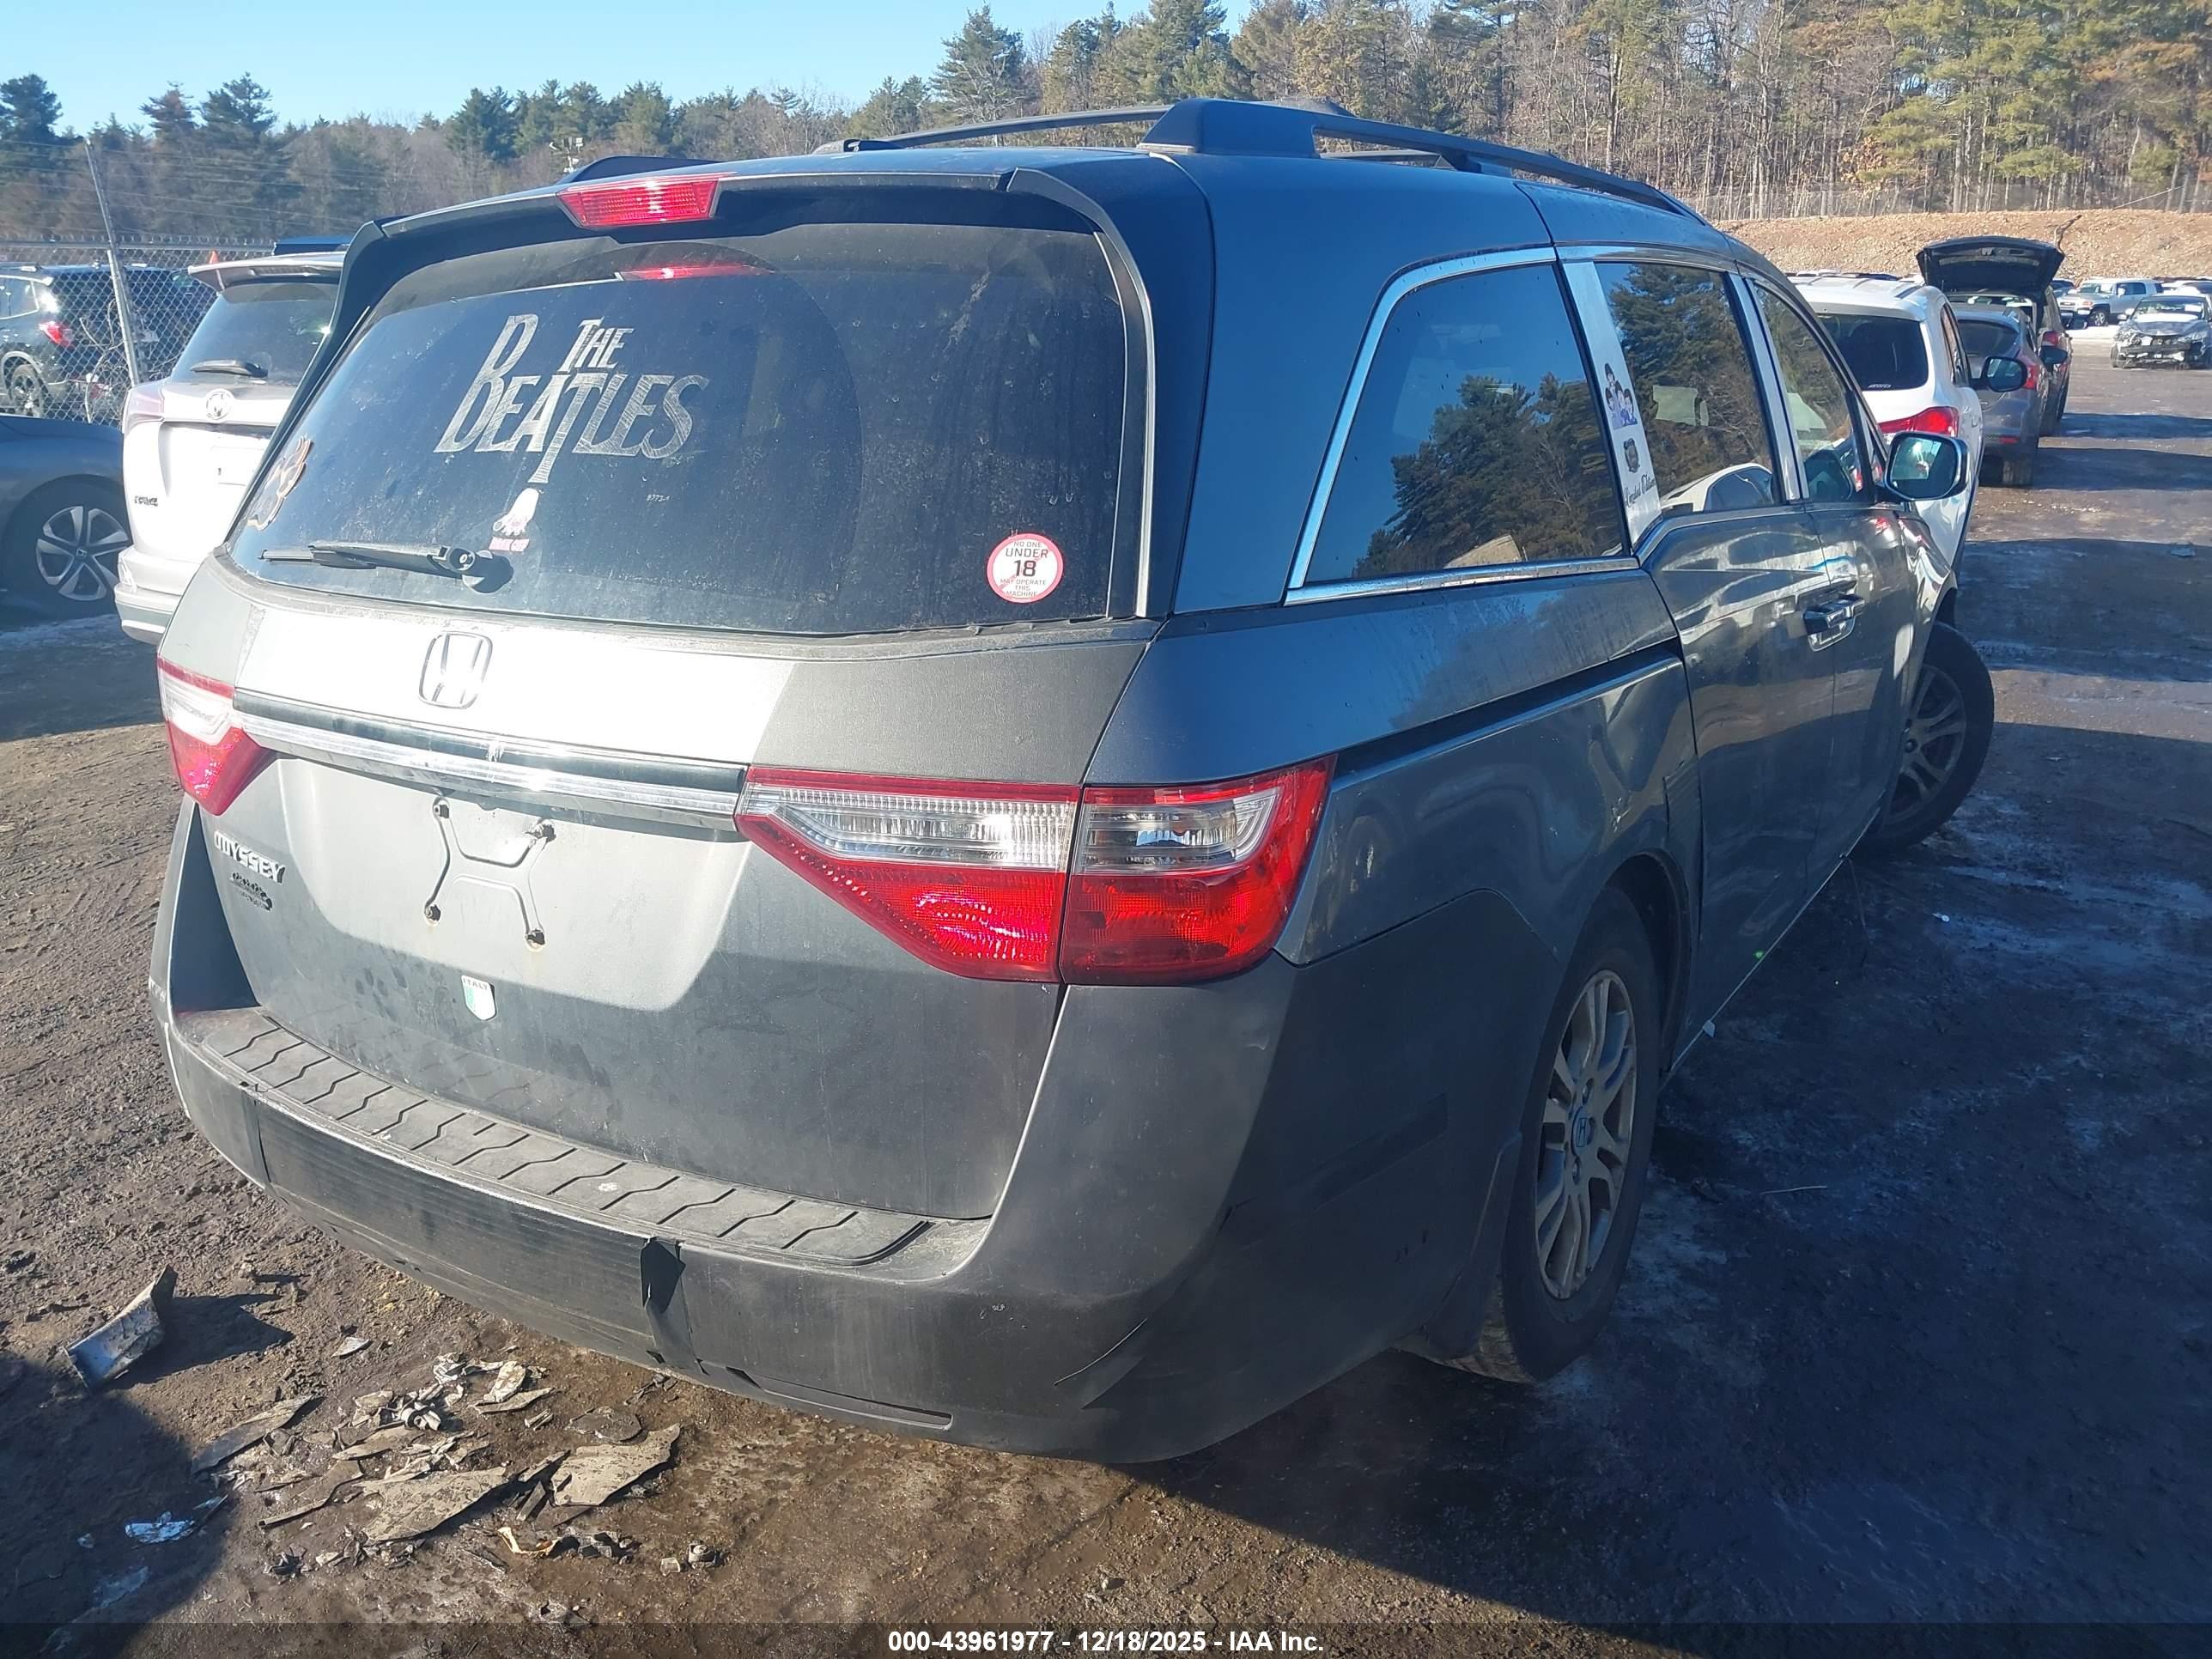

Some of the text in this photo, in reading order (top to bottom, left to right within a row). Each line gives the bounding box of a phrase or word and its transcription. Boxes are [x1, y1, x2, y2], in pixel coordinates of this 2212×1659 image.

[557, 318, 633, 373] THE
[433, 314, 709, 483] BEATLES
[1006, 548, 1048, 558] UNDER
[1014, 559, 1036, 577] 18
[214, 830, 286, 885] ODYSSEY
[463, 977, 488, 990] ITALY
